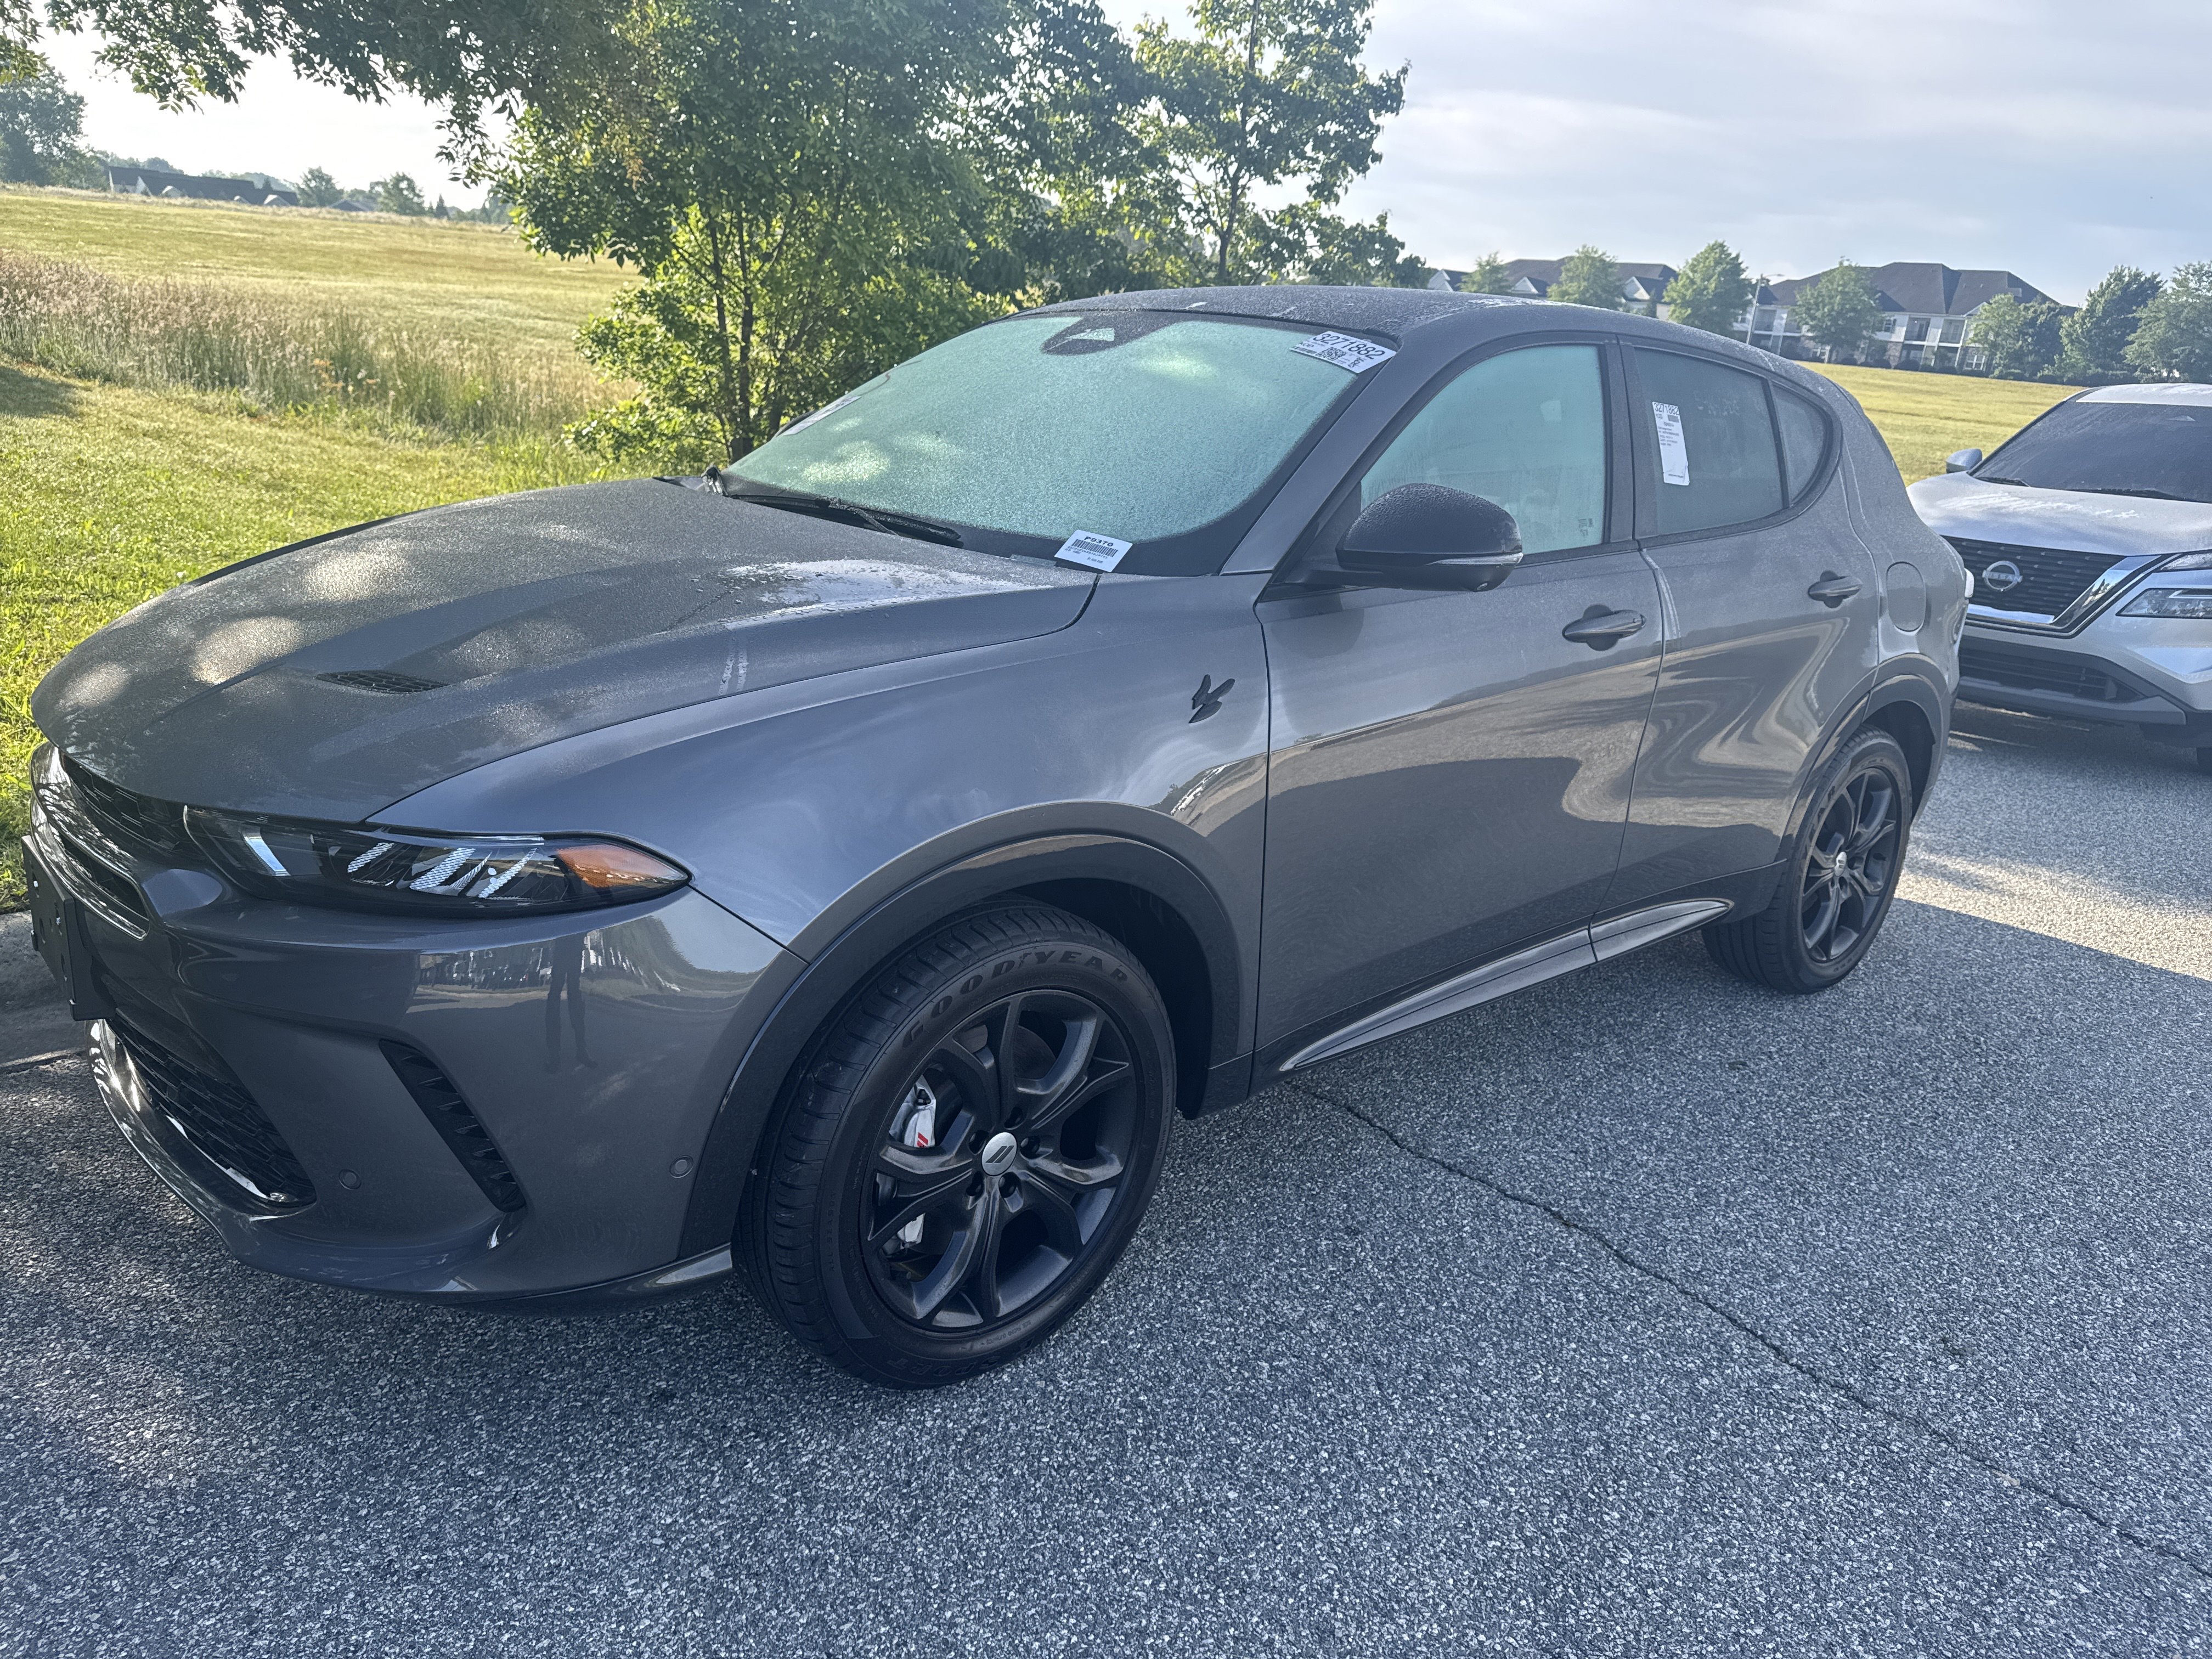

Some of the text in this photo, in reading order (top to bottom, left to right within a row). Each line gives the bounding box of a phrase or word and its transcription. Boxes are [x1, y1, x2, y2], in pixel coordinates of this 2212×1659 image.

[1313, 334, 1385, 359] 3271882
[1654, 402, 1679, 415] 3271882
[1084, 536, 1114, 547] P9370
[903, 950, 1128, 1048] GOODYEAR
